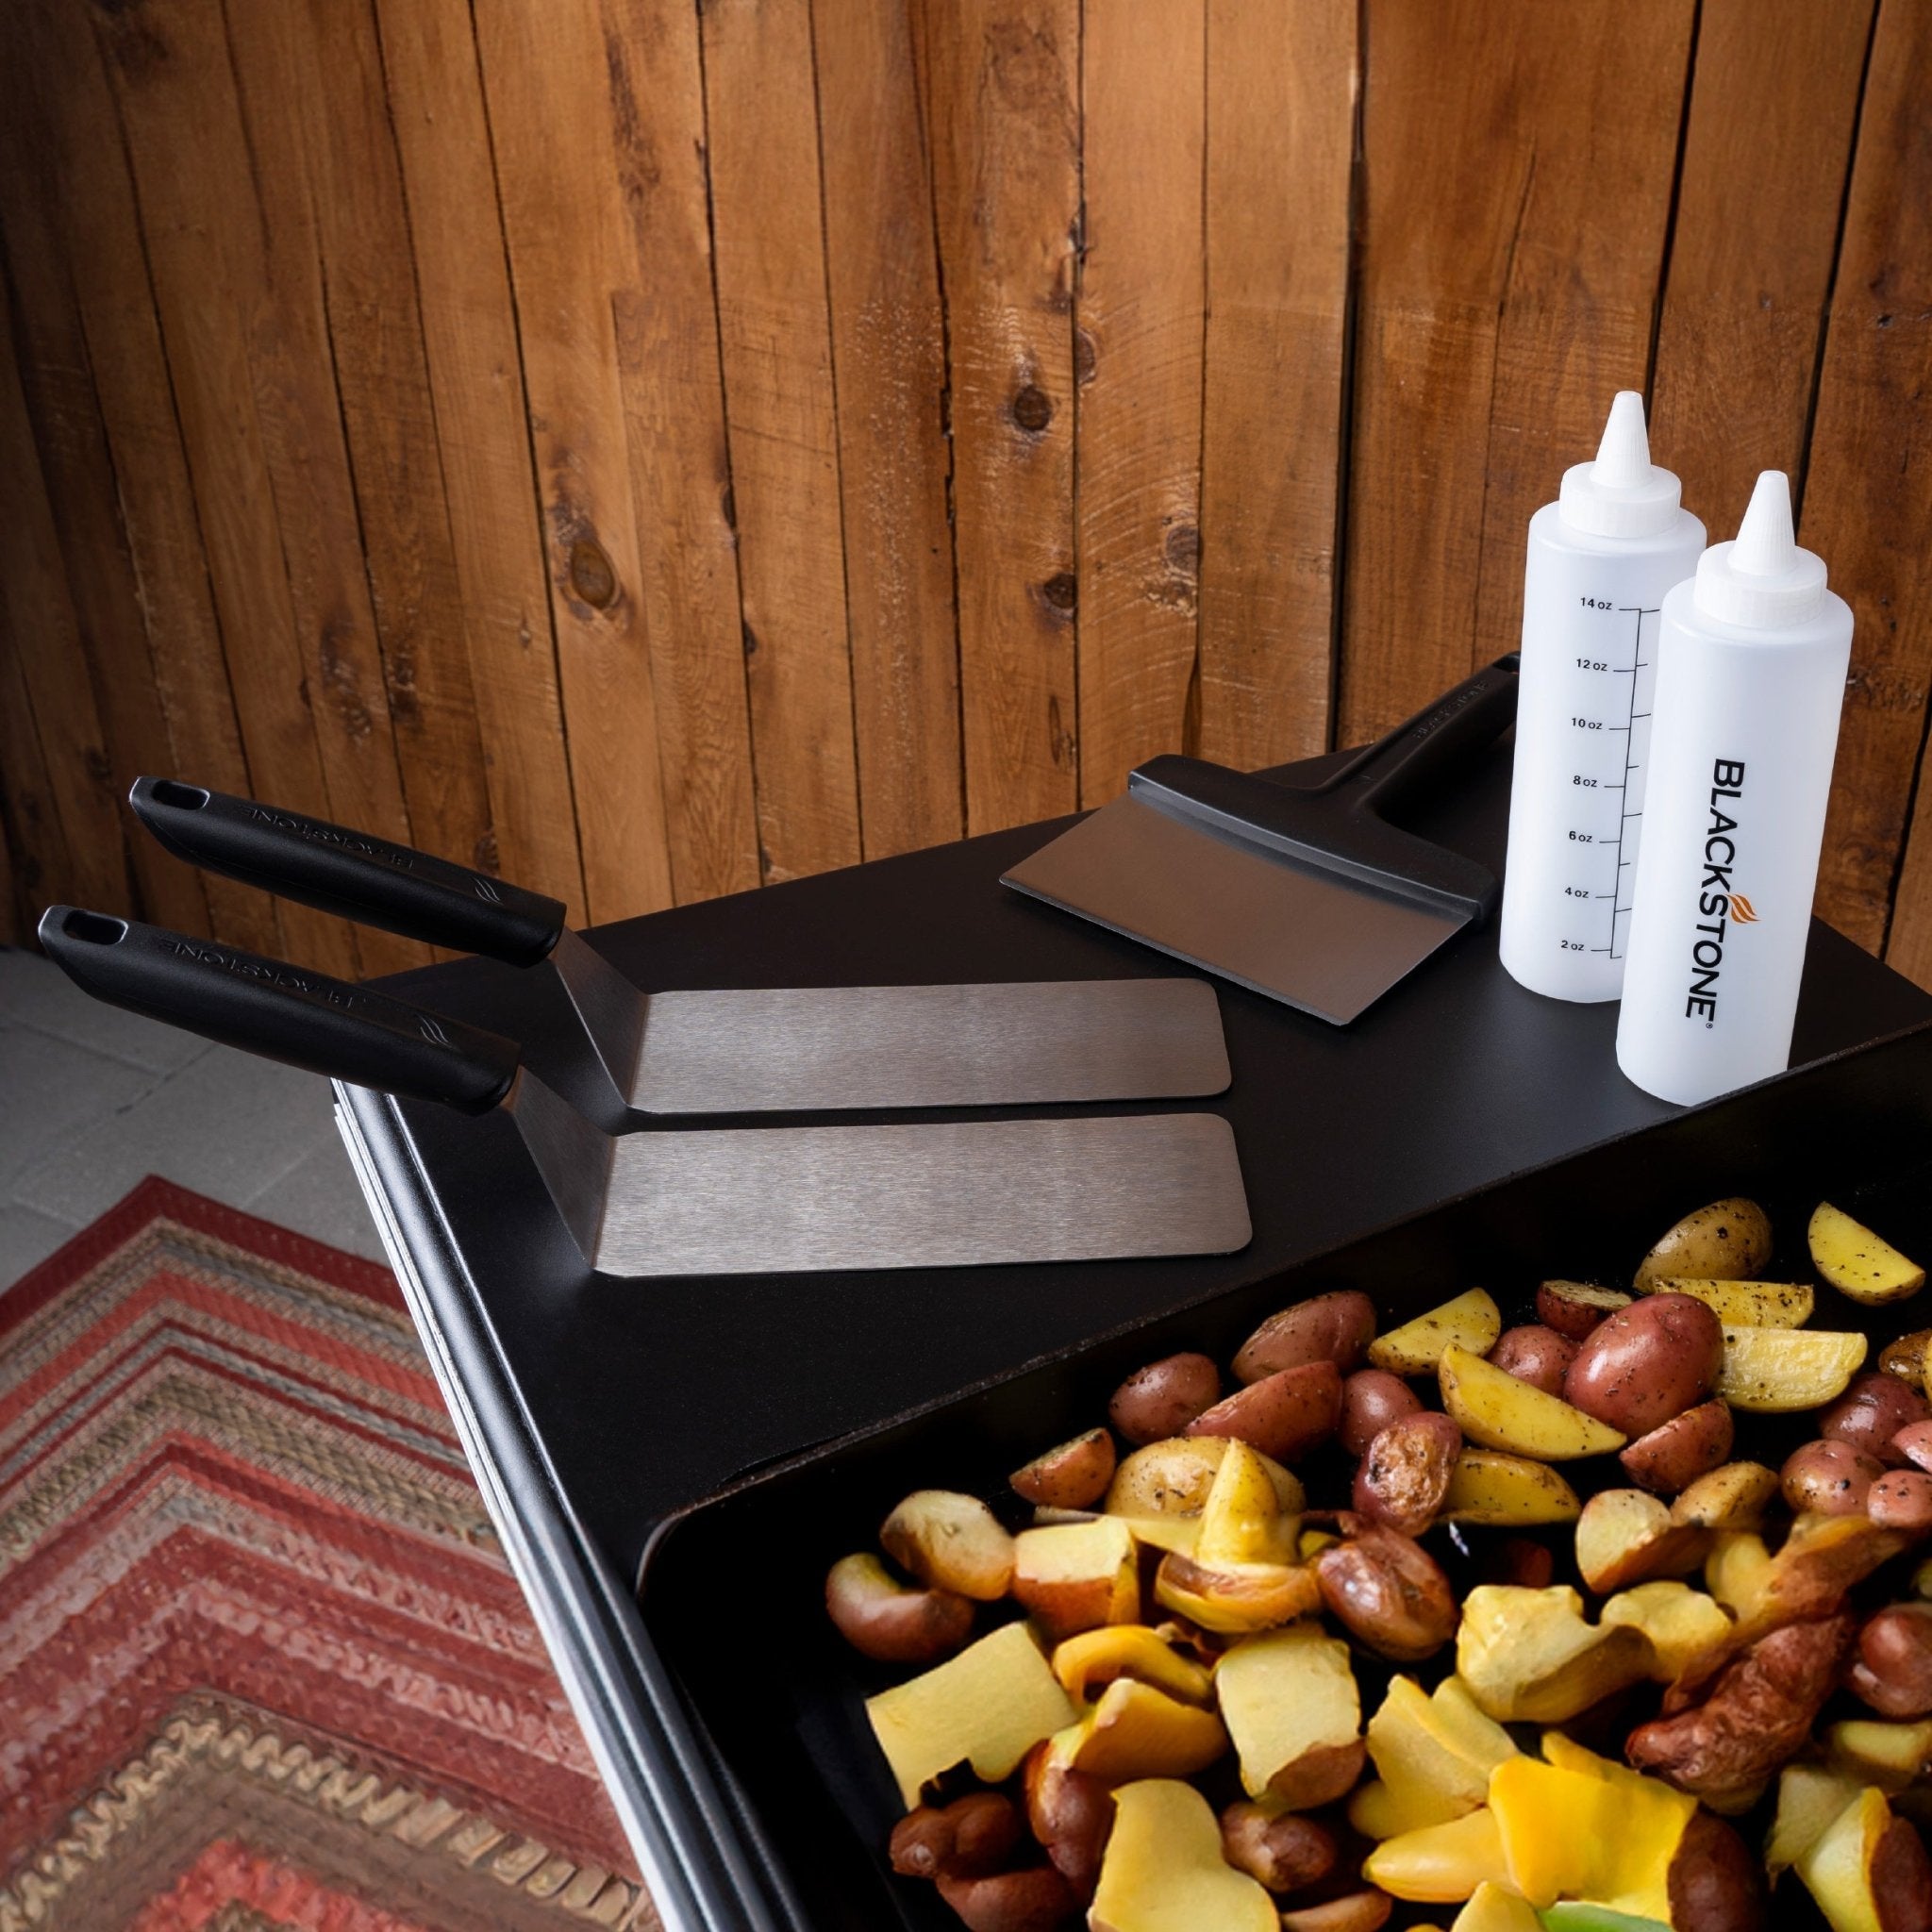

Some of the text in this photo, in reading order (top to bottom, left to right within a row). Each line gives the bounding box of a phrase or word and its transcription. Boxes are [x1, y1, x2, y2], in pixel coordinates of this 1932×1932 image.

[1580, 597, 1612, 610] 14 oz
[1576, 658, 1607, 672] 12 oz
[1572, 717, 1603, 730] 10 oz
[1573, 775, 1597, 788] 8 oz
[1569, 831, 1592, 843] 6 oz
[1564, 887, 1589, 899] 4 oz
[1685, 758, 1745, 1022] BLACKSTONE
[1560, 940, 1585, 952] 2 oz
